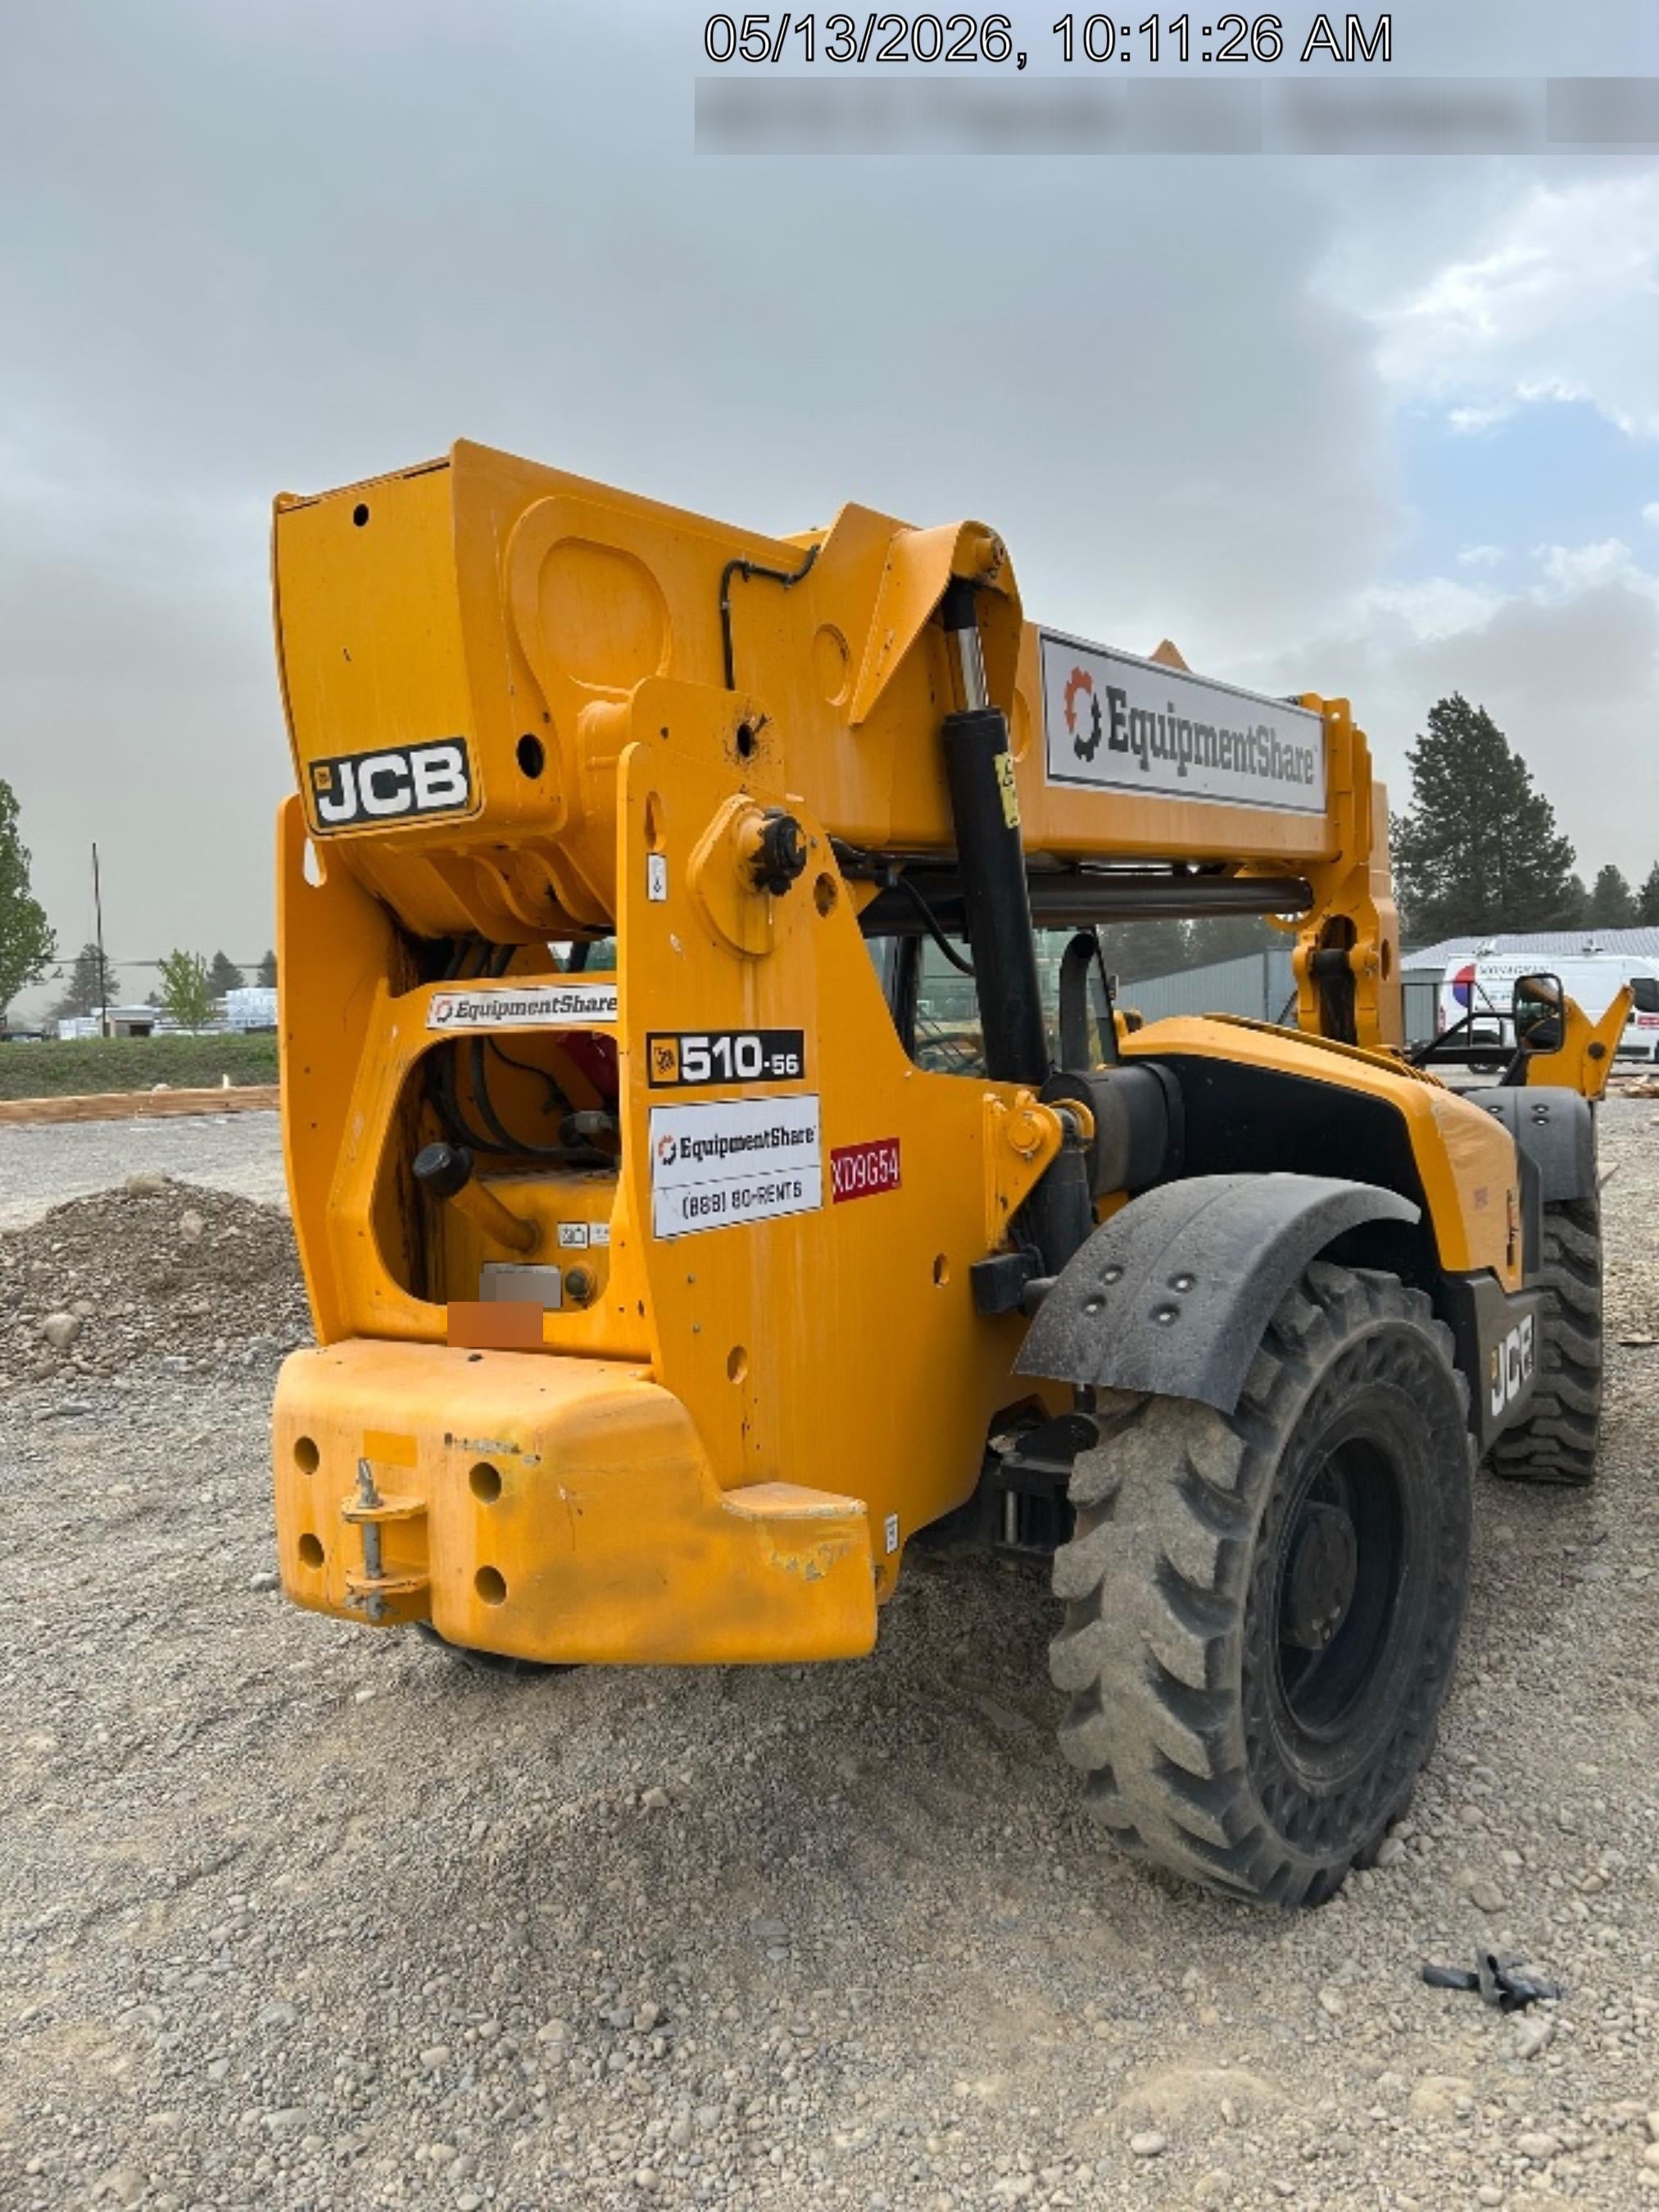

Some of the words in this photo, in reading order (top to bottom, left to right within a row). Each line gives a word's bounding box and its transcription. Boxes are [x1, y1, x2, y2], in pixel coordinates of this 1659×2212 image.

[1106, 685, 1314, 785] EquipmentShare
[318, 746, 468, 822] JCB
[455, 995, 618, 1022] EquipmentShare
[680, 1125, 814, 1162] EquipmentShare
[682, 1191, 726, 1220] (888)
[731, 1181, 802, 1210] 80-RENTS
[1491, 1314, 1534, 1417] JCB
